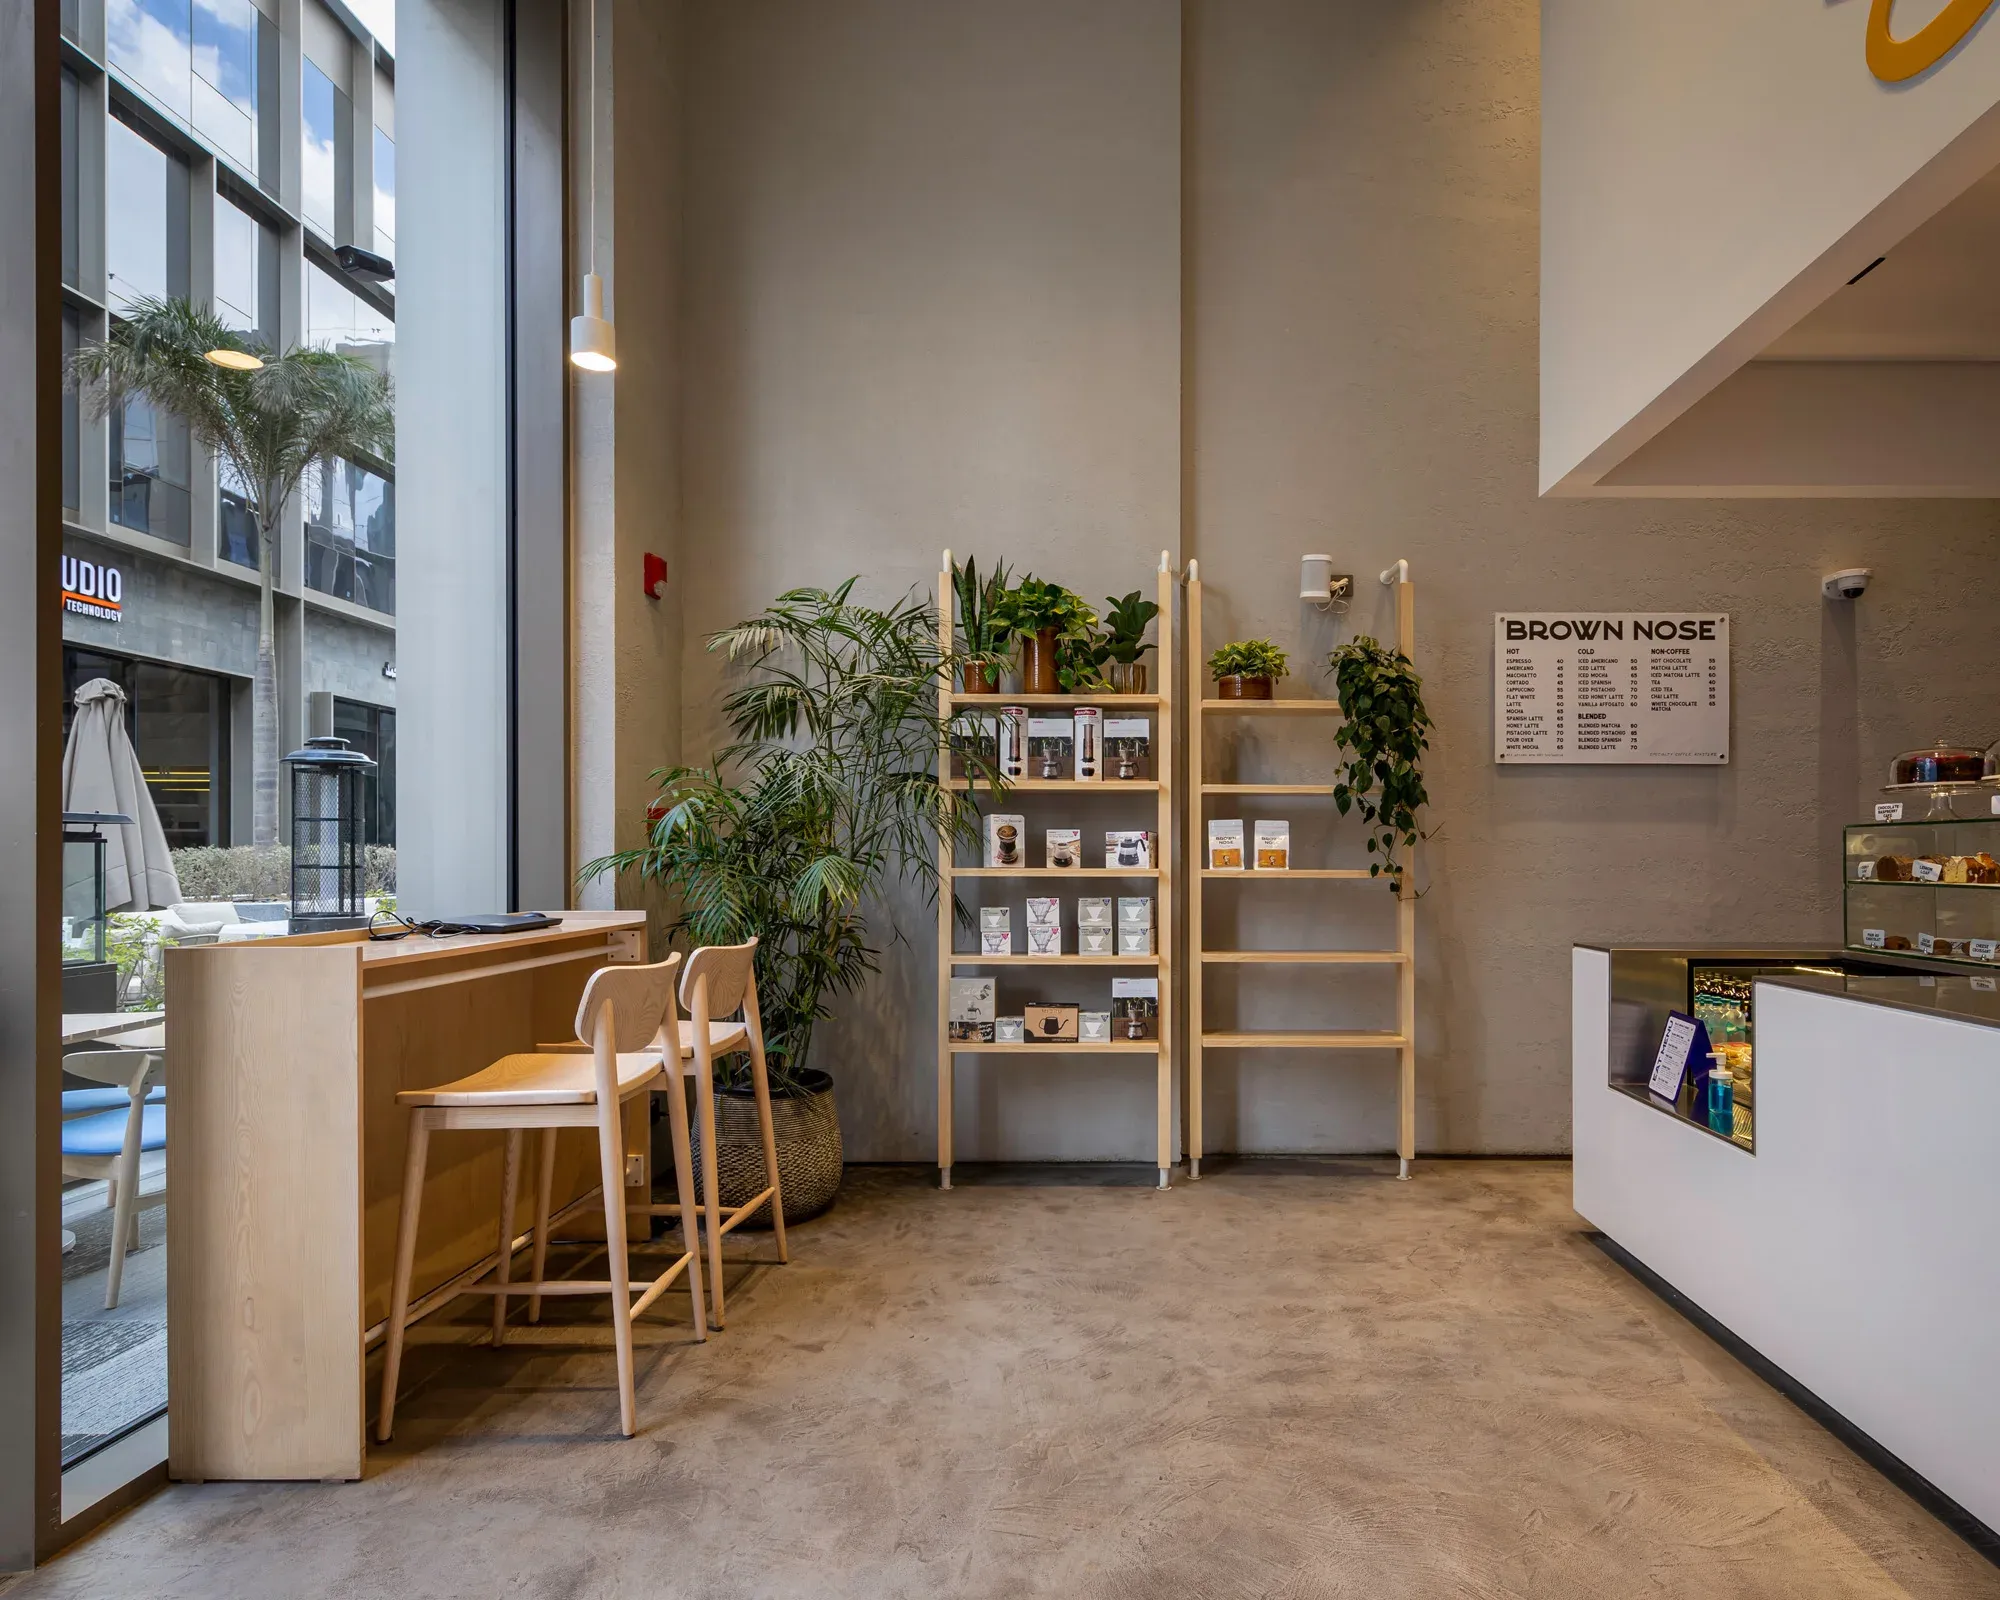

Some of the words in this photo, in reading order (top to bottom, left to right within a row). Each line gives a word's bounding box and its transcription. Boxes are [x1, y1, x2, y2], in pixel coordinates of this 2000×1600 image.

[62, 555, 122, 603] UDIO
[65, 598, 122, 623] TECHNOLOGY
[1506, 620, 1623, 640] BROWN
[1633, 620, 1716, 641] NOSE
[1652, 1057, 1662, 1081] EAT
[1661, 1020, 1673, 1054] MENU
